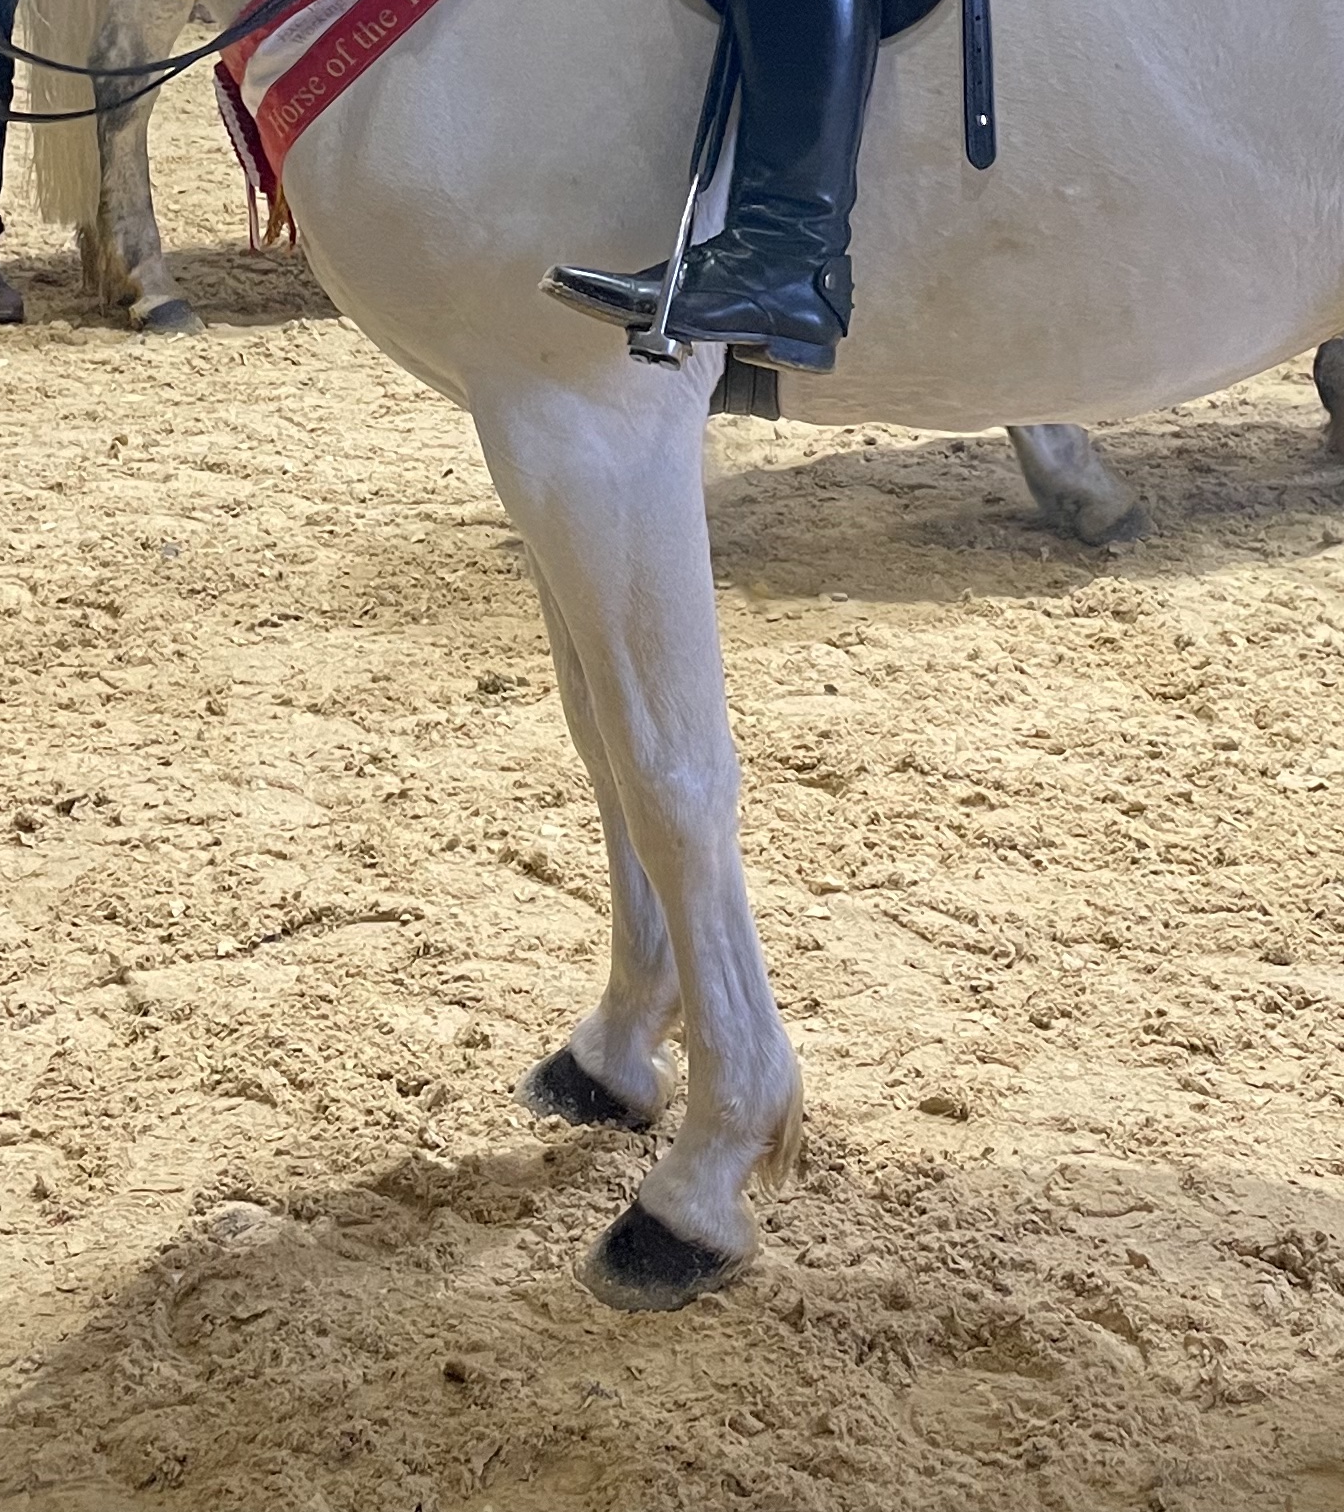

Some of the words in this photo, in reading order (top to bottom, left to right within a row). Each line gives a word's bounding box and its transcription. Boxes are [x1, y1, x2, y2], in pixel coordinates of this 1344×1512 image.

[268, 74, 327, 139] Horse
[327, 38, 360, 78] of
[355, 9, 399, 51] the
